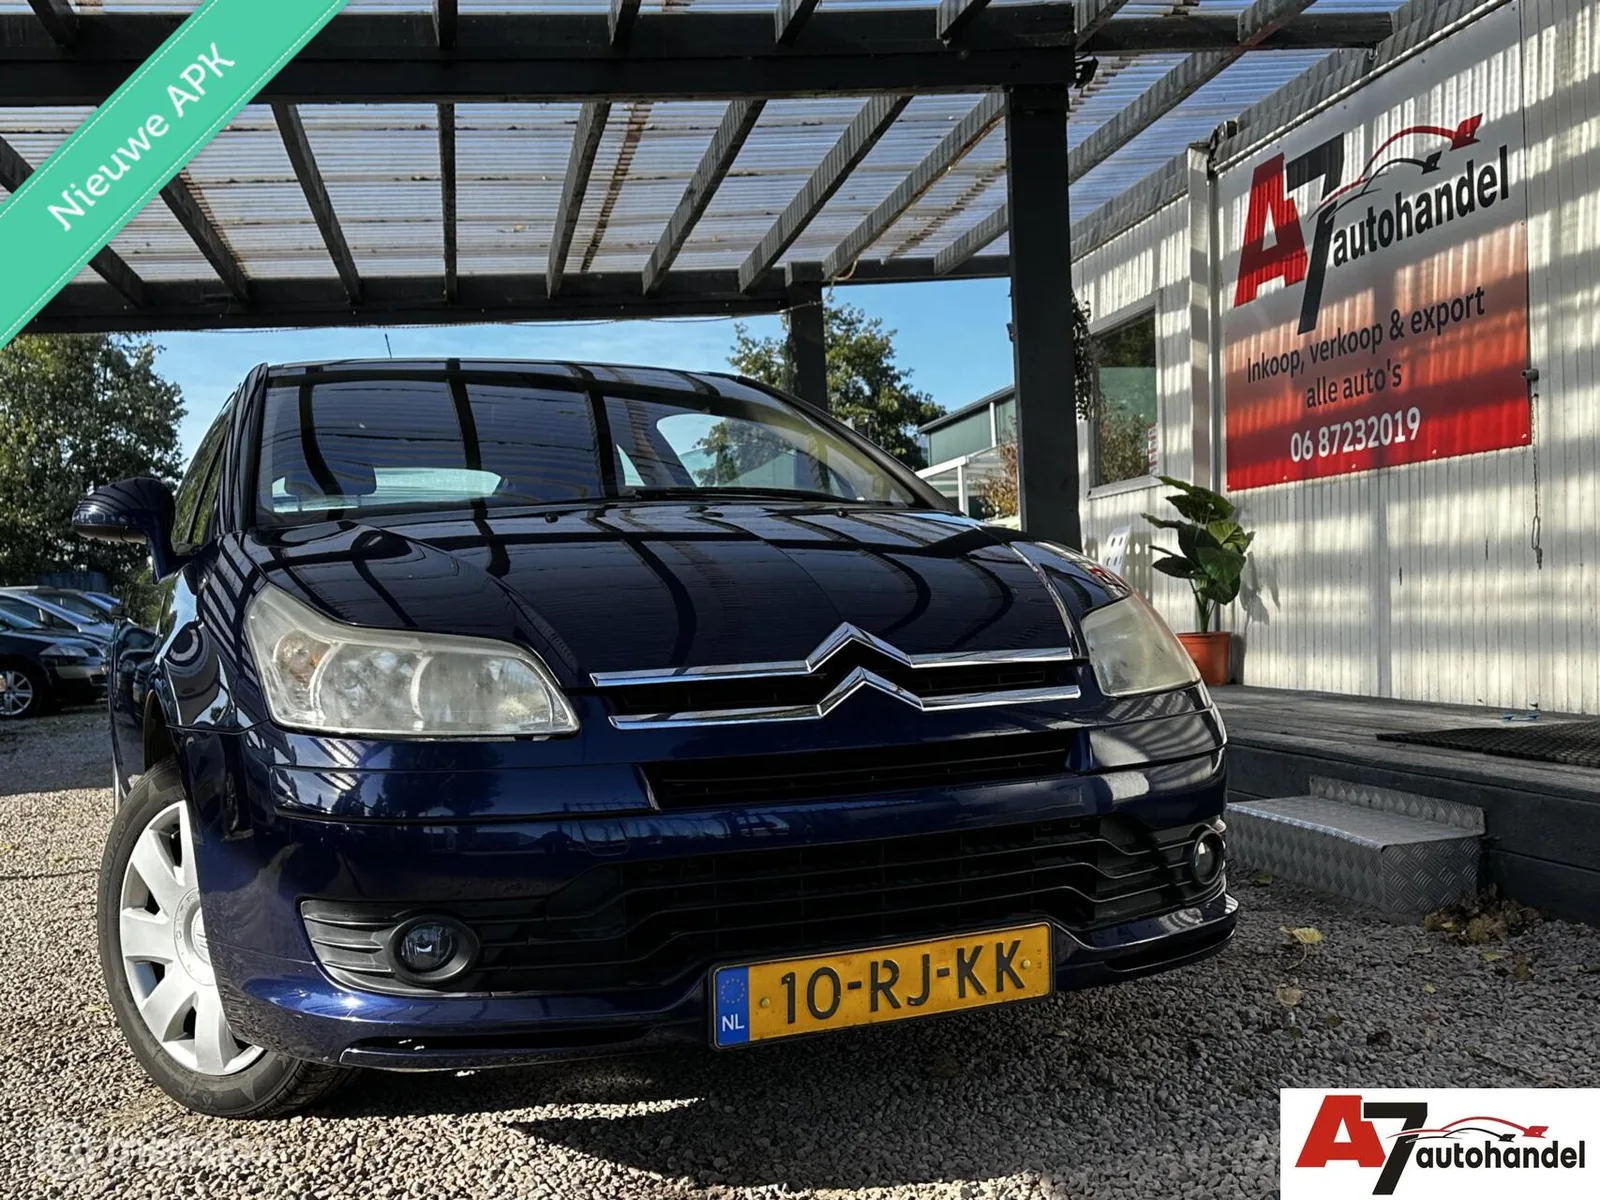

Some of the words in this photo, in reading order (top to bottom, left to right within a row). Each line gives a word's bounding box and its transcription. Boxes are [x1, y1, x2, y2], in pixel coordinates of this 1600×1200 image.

[1233, 132, 1345, 336] A7
[1332, 144, 1510, 268] autohandel
[1246, 350, 1306, 384] Inkoop,
[1309, 324, 1384, 365] verkoop
[1389, 309, 1405, 341] &
[1410, 286, 1486, 335] export
[1306, 373, 1338, 410] alle
[1342, 360, 1403, 400] auto's
[1289, 430, 1314, 463] 06
[1317, 406, 1422, 459] 87232019
[780, 939, 1026, 1025] 10-RJ-KK
[721, 1012, 745, 1032] NL
